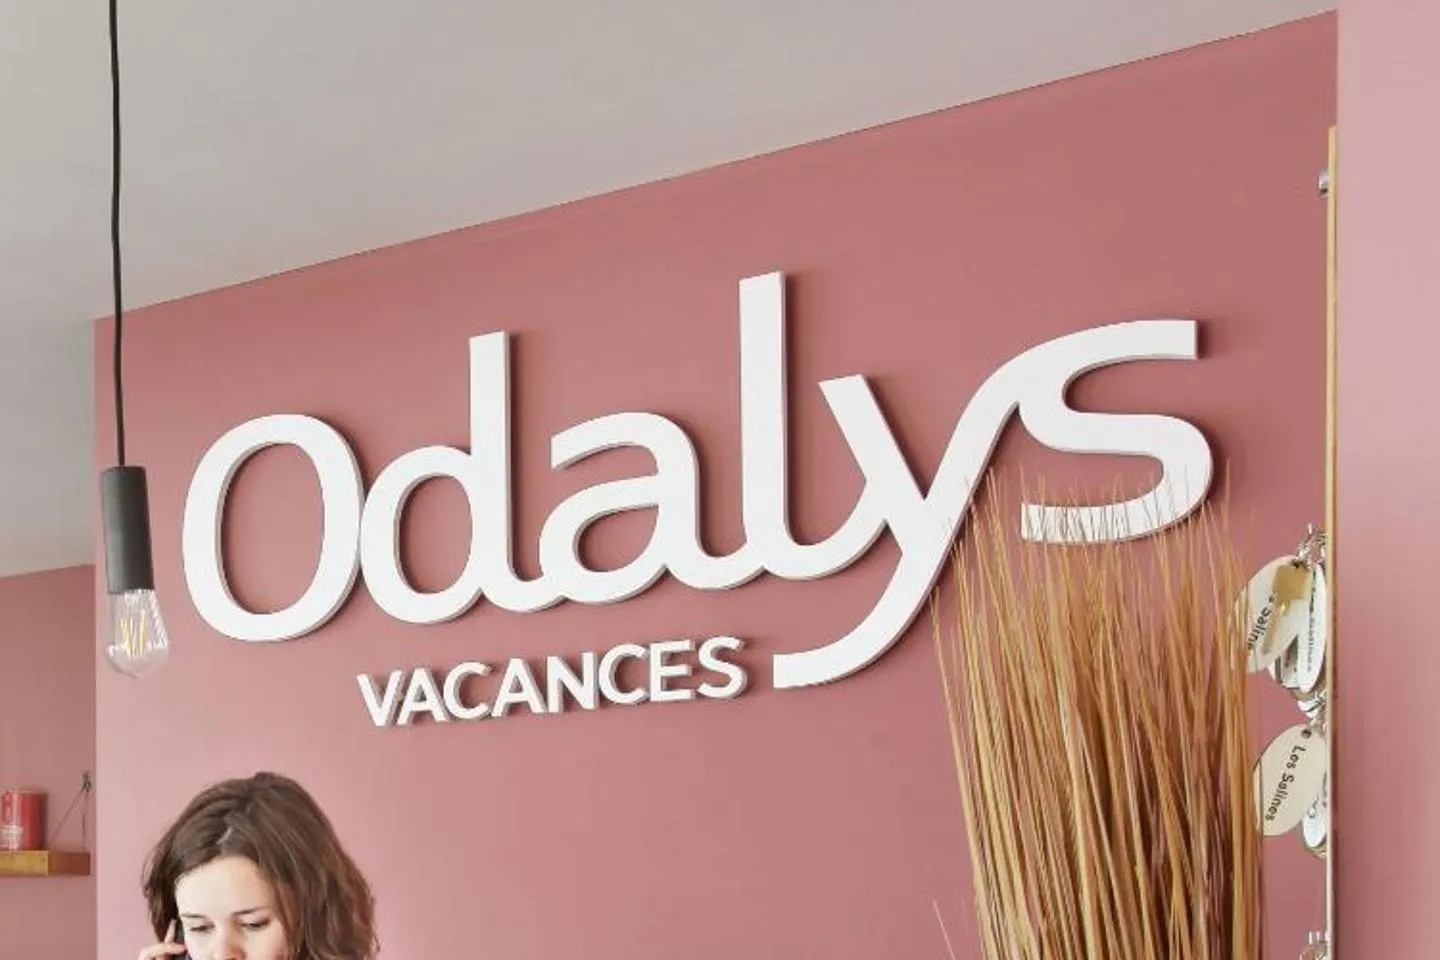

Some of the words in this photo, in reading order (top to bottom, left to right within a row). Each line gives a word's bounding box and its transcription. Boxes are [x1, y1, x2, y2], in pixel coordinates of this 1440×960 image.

[182, 270, 1213, 689] Odalys
[357, 636, 745, 728] VACANCES
[1286, 745, 1306, 769] Les
[1264, 773, 1295, 821] Salines
